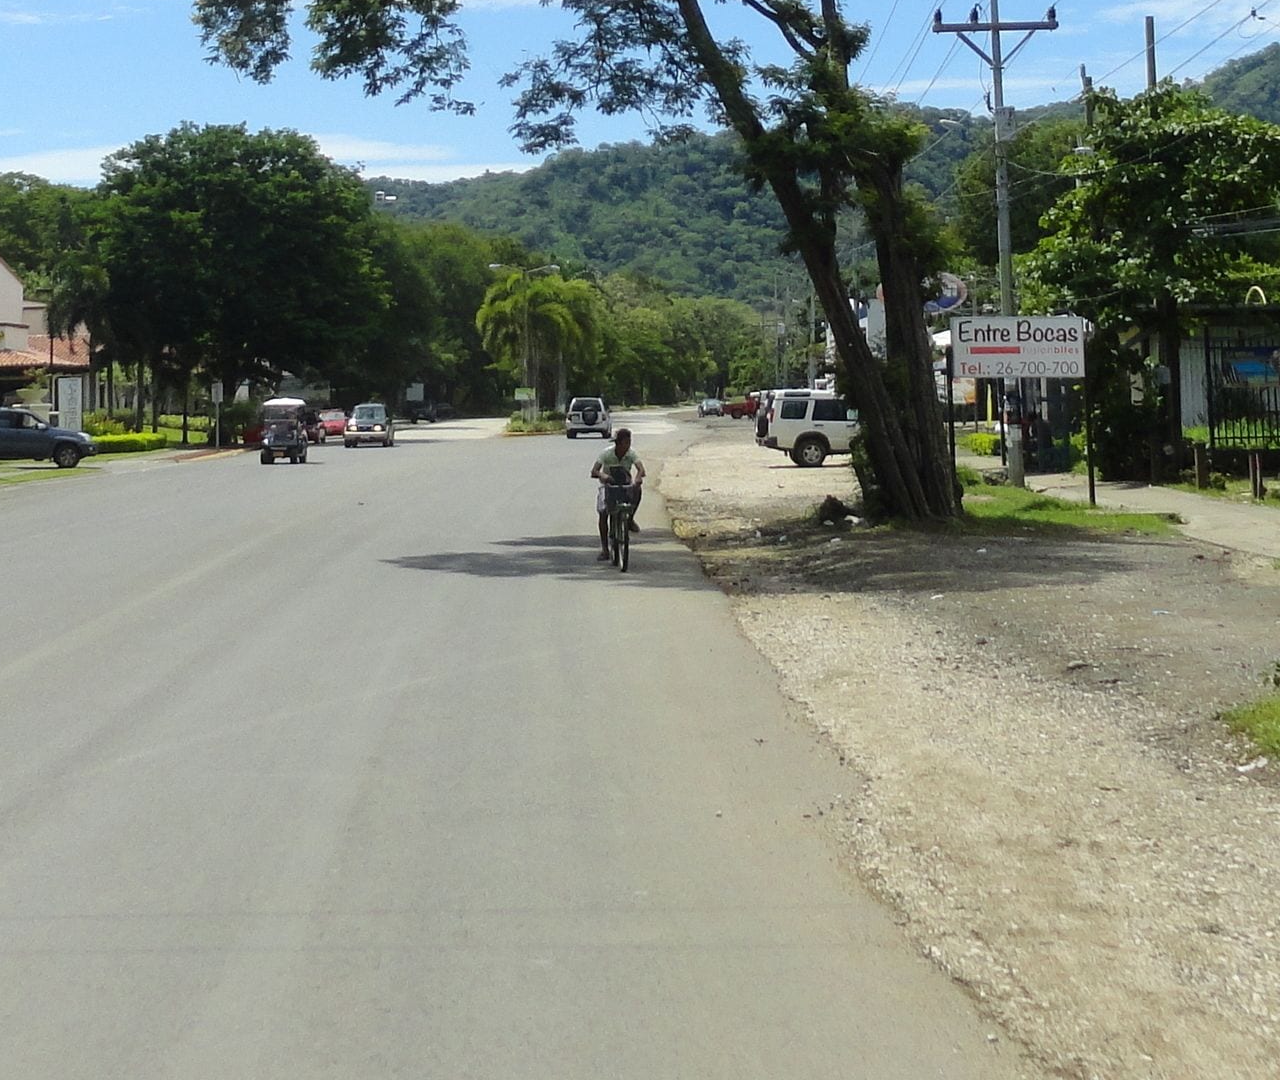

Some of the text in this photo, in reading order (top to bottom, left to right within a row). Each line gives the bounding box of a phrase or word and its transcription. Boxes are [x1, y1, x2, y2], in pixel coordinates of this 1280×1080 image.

[958, 320, 1079, 343] Entre Bocas
[995, 360, 1079, 376] 26-700-700
